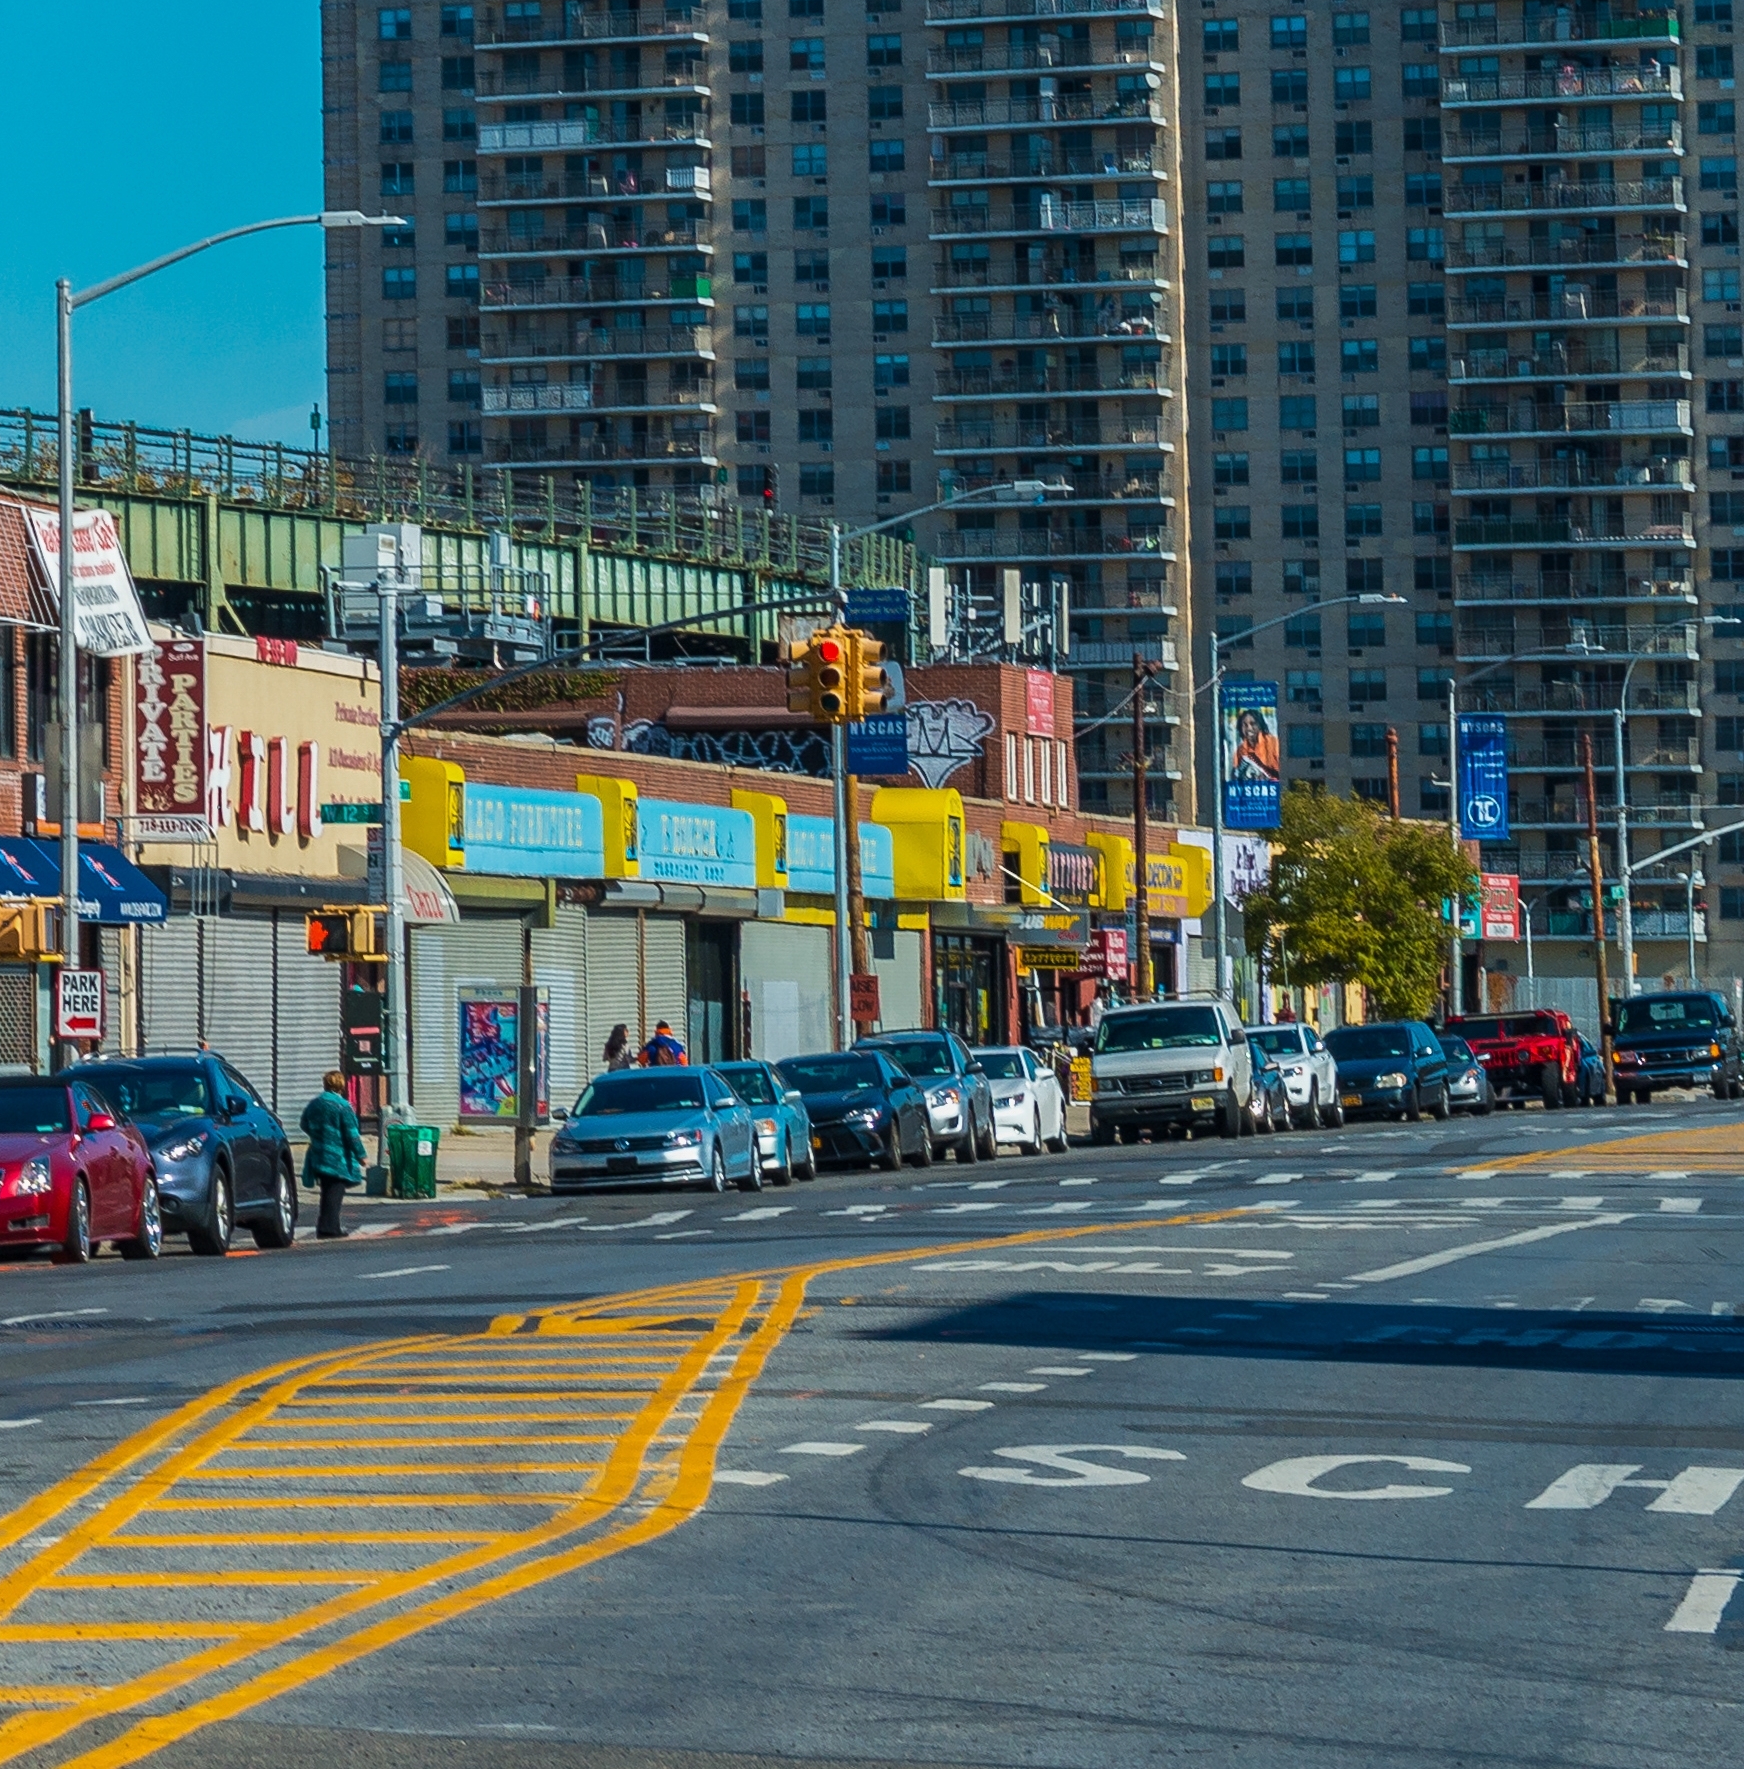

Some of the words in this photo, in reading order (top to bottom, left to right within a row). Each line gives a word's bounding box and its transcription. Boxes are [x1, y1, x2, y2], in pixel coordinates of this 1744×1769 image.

[138, 644, 167, 782] PRIVATE
[850, 720, 904, 736] NYSCAS
[169, 674, 200, 804] PARTIES
[343, 805, 357, 822] 12
[63, 974, 98, 993] PARK
[63, 994, 99, 1013] HERE
